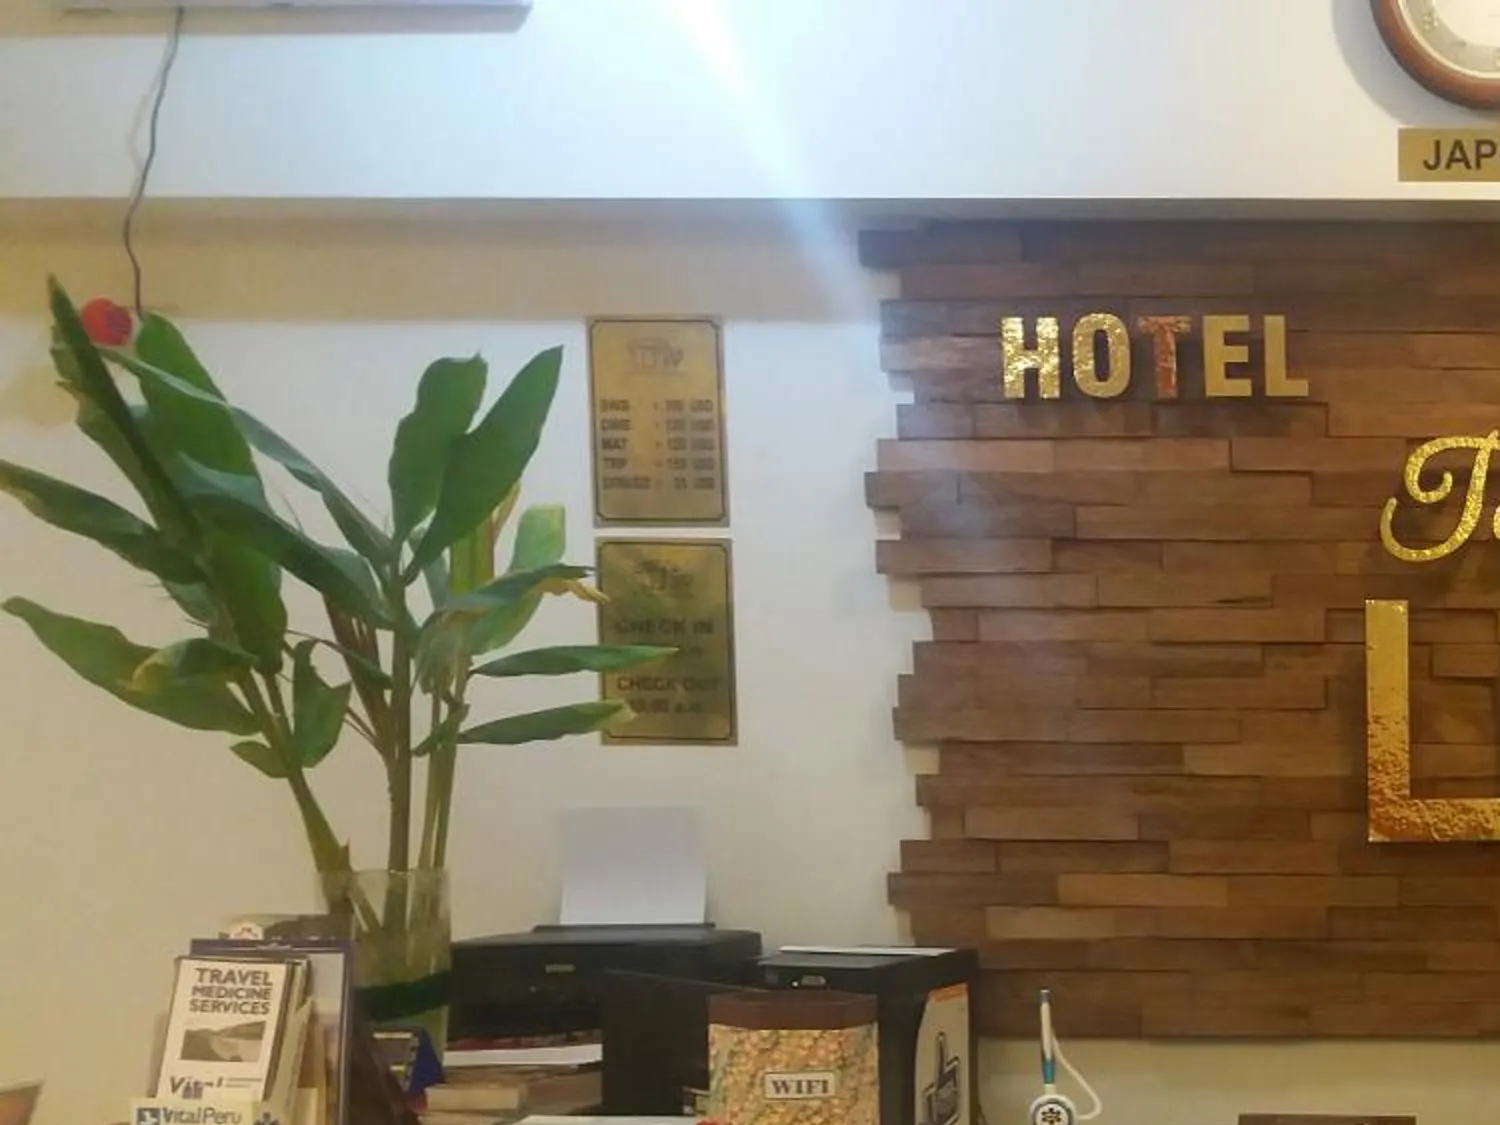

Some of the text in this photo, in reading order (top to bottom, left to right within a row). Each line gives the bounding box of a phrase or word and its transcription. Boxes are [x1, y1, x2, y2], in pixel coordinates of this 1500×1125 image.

[1001, 313, 1310, 400] HOTEL
[614, 618, 685, 635] CHECK
[616, 675, 681, 692] CHECK
[195, 967, 273, 987] TRAVEL
[191, 985, 272, 1000] MEDICINE
[189, 999, 271, 1015] SERVICES
[771, 1079, 829, 1097] WIFI
